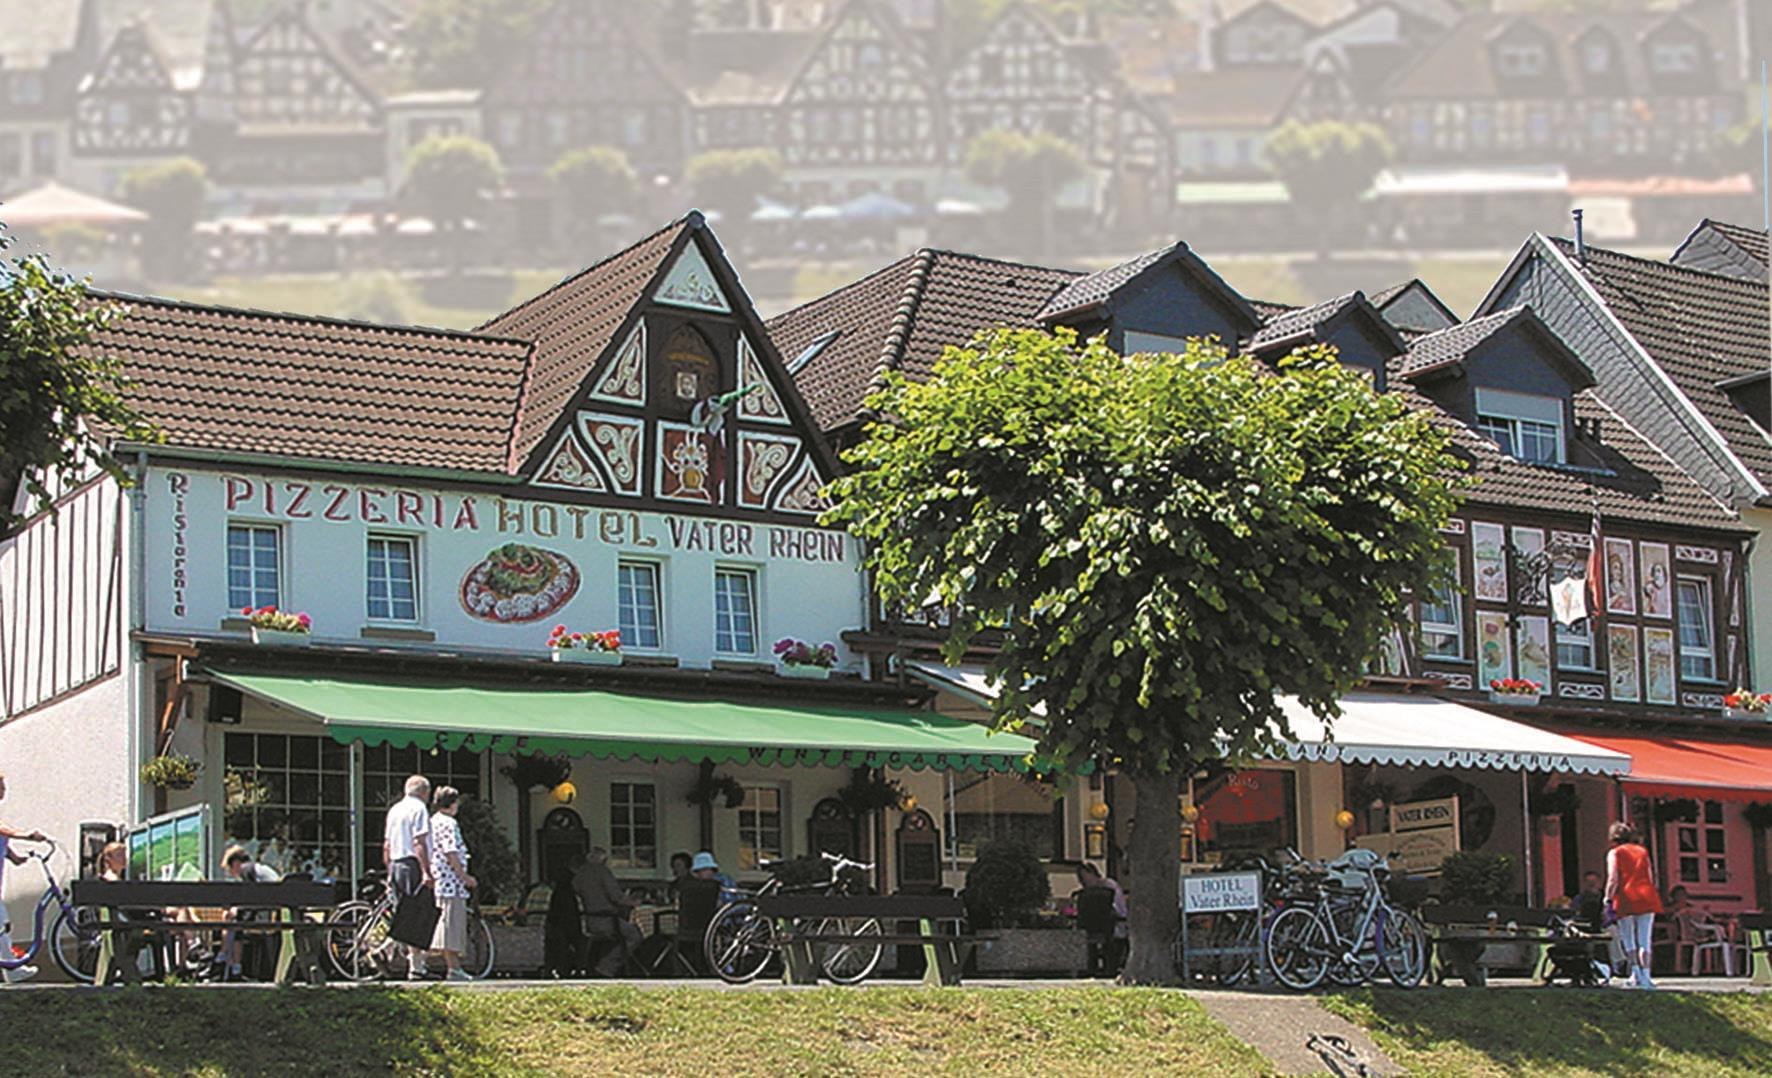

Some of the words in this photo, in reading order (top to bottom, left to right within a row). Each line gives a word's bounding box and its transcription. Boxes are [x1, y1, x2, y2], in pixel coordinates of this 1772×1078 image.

[220, 474, 479, 531] PIZZERIA
[167, 472, 188, 616] Ristorante
[436, 731, 529, 748] CAFE
[750, 747, 1015, 767] WINTERGARTEN
[1448, 751, 1571, 766] PIZZERIA
[1201, 879, 1242, 893] HOTEL
[1190, 894, 1220, 909] Vater
